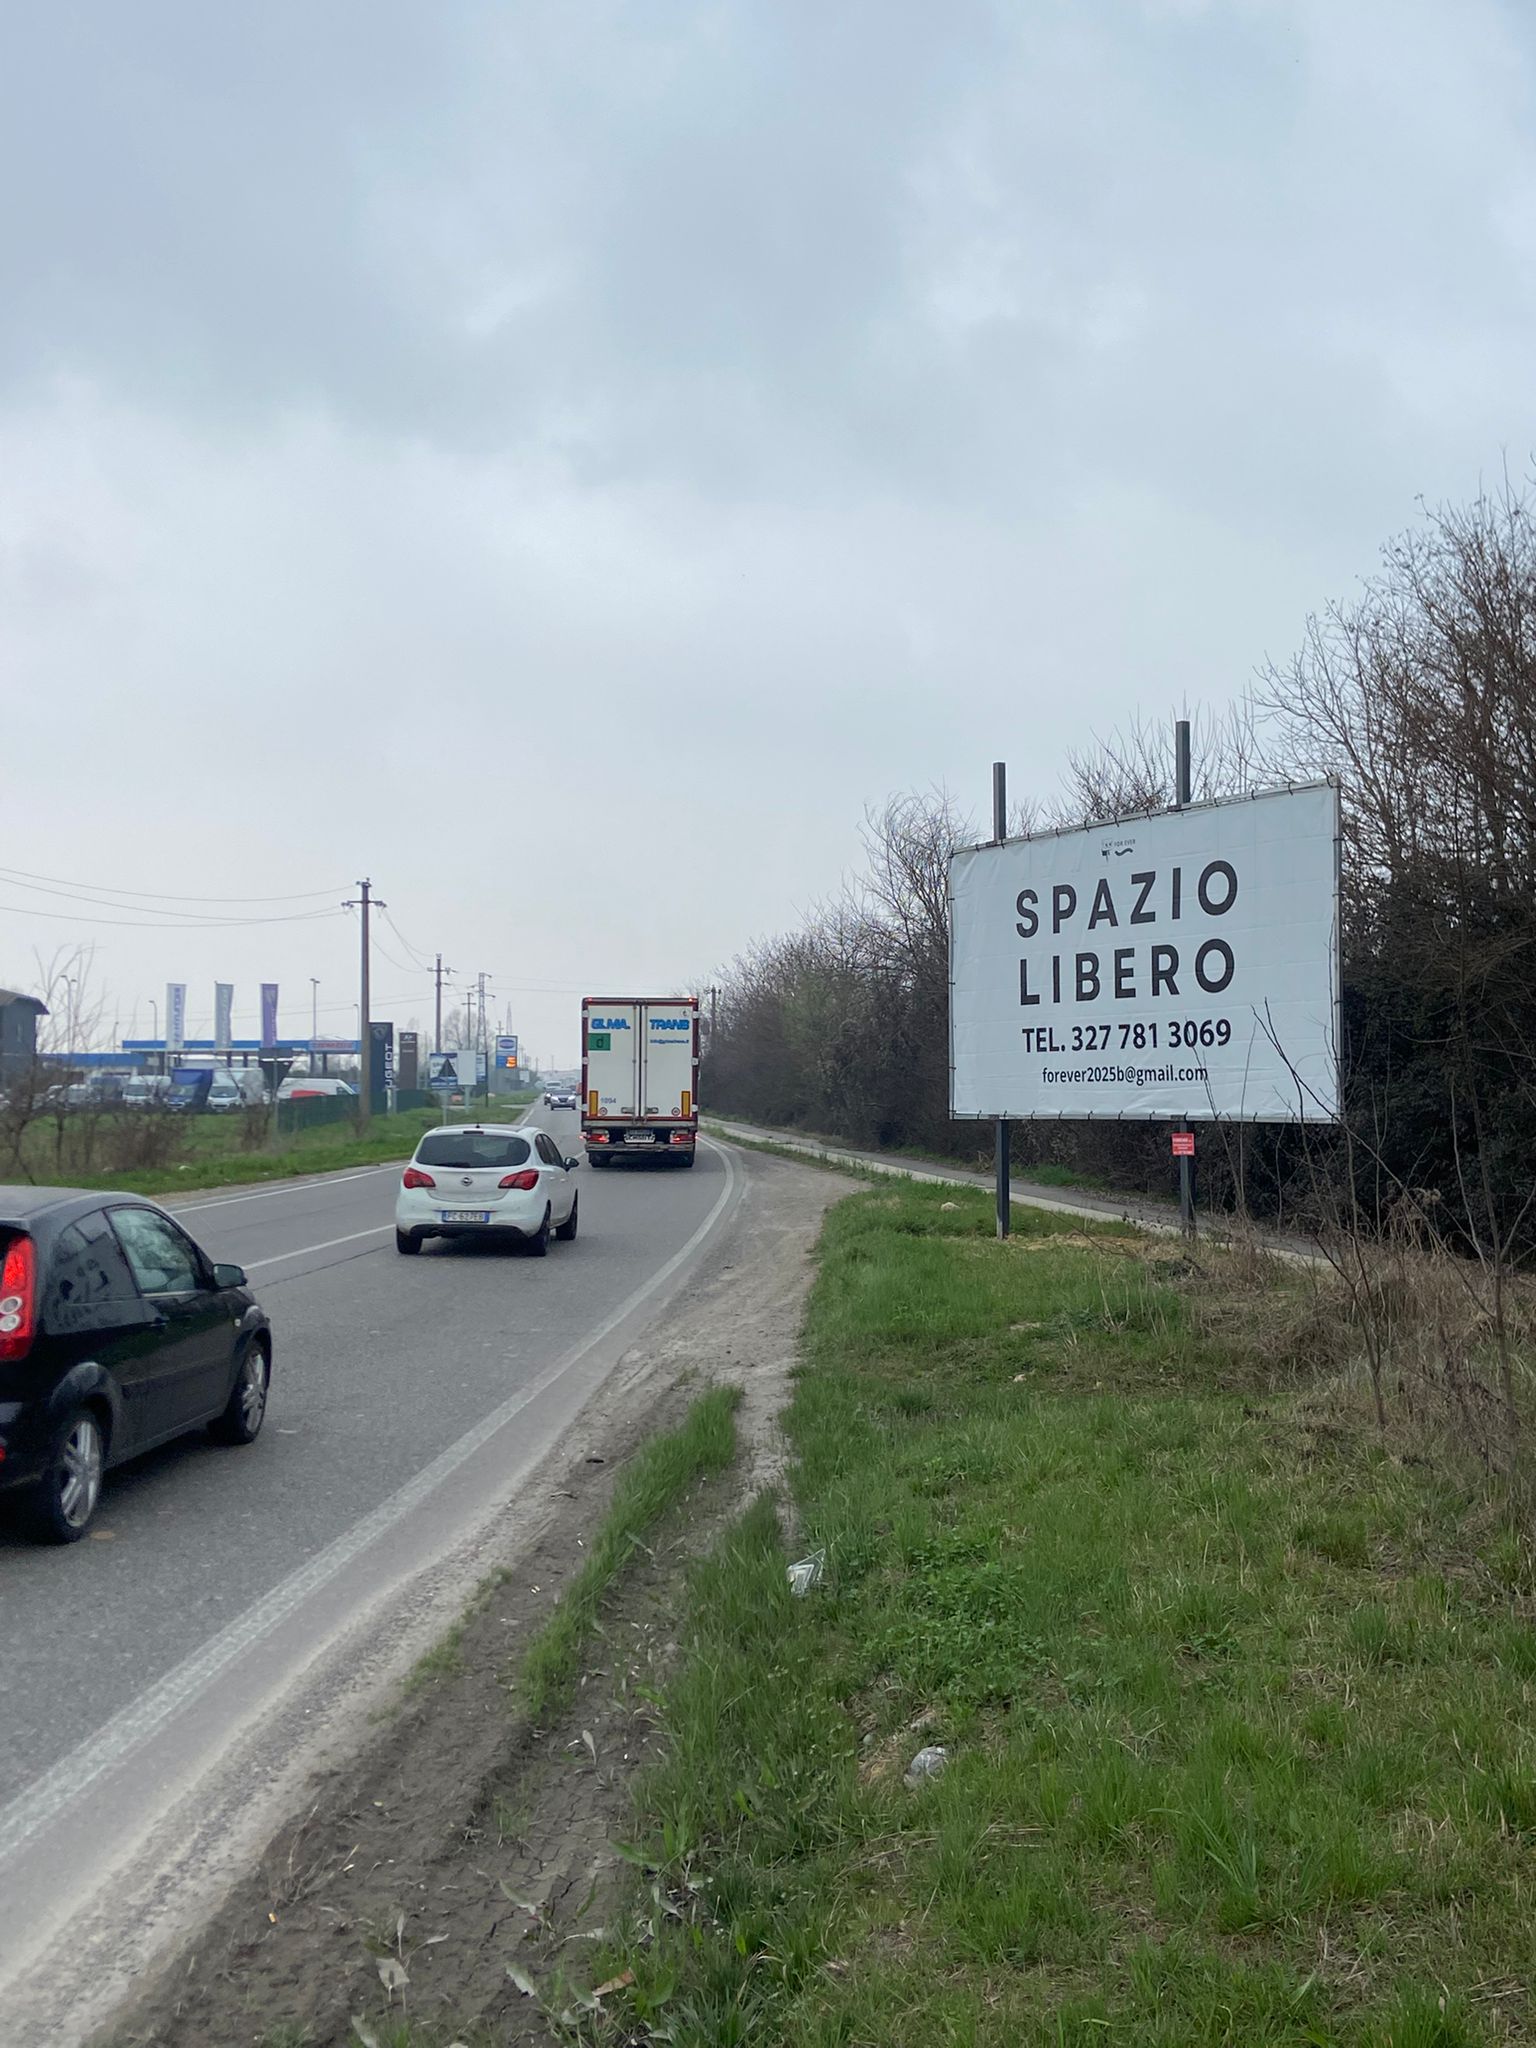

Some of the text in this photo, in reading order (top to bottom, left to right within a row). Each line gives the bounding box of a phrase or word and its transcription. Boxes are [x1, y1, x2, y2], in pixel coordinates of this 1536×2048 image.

[1015, 860, 1238, 939] SPAZIO
[1019, 938, 1235, 1006] LIBERO
[1021, 1018, 1232, 1053] TEL. 327 781 3069
[384, 1043, 394, 1089] UGEOT
[1042, 1064, 1208, 1087] forever2025b@gmail.com
